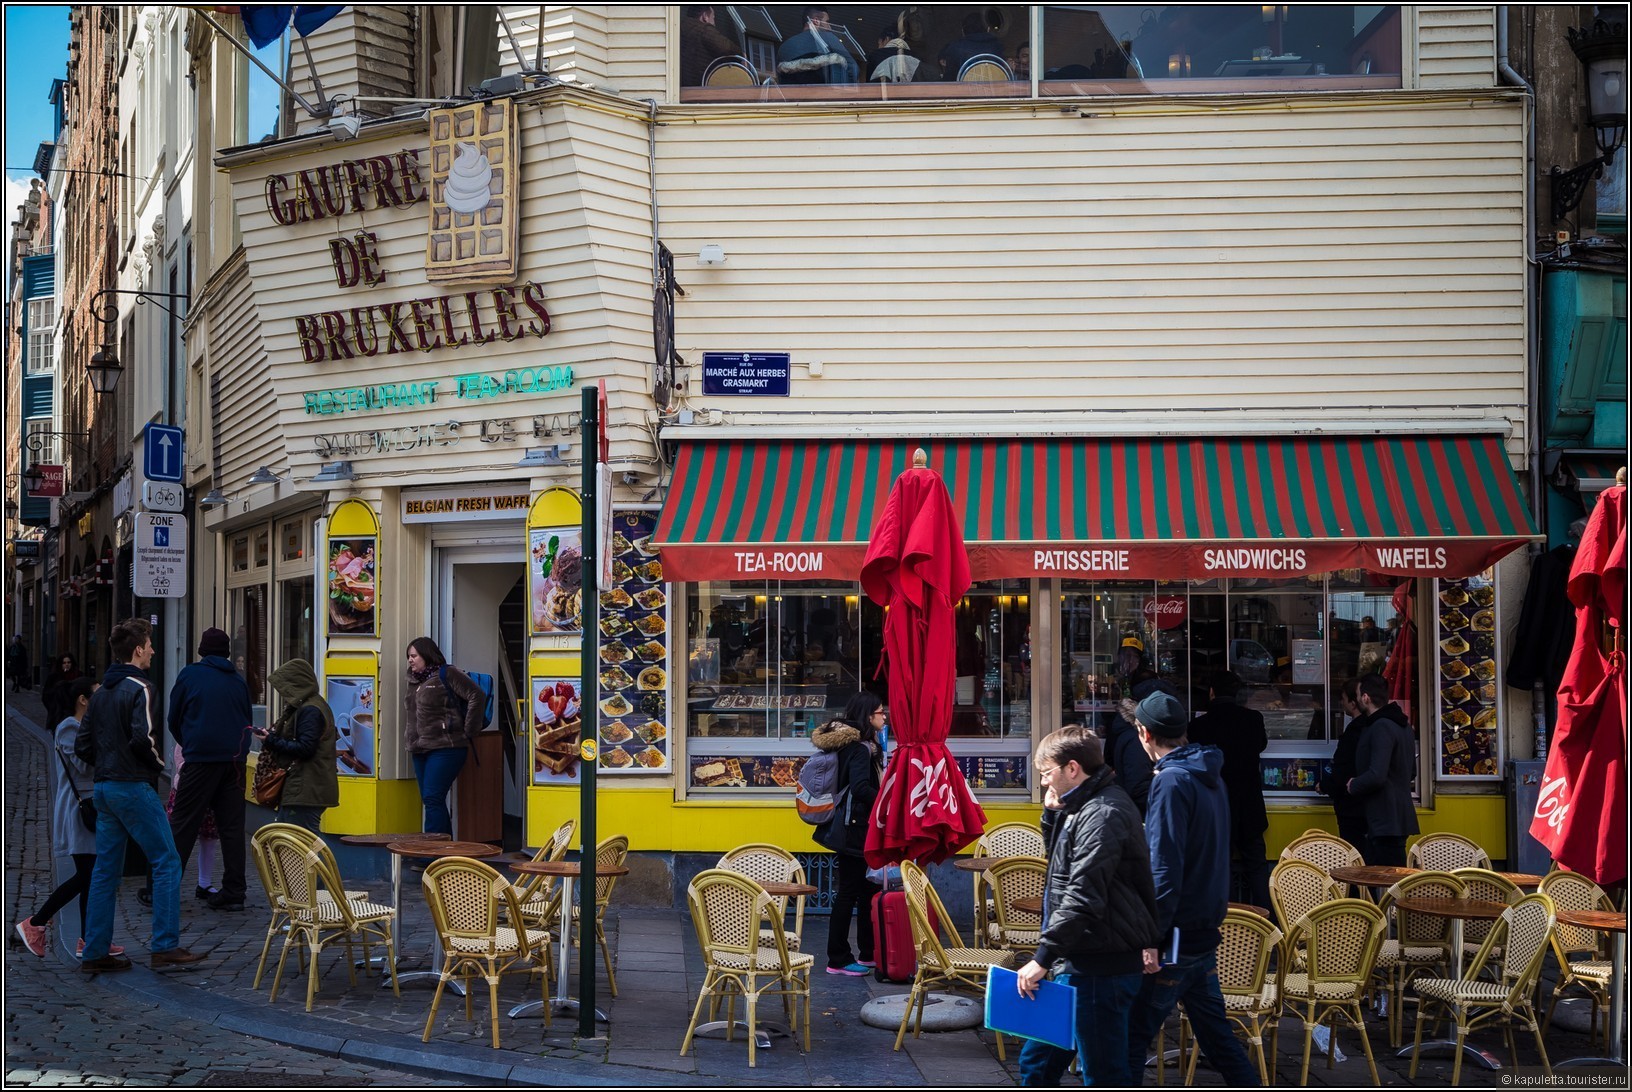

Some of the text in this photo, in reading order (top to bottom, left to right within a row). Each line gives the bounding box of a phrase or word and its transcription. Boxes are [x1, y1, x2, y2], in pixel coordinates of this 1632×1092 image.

[264, 149, 429, 226] GAUFRE
[328, 230, 386, 288] DE
[295, 280, 551, 364] BRUXELLES
[706, 367, 786, 378] MARCHÉ AUX HERBES
[723, 379, 769, 388] GRASMARKT
[304, 381, 439, 415] RESTAURANT
[314, 420, 461, 457] SANDWICHES
[479, 418, 516, 443] ICE
[406, 494, 531, 515] BELGIAN FRESH WAFFL
[150, 516, 174, 526] ZONE
[734, 552, 823, 572] TEA-ROOM
[1034, 550, 1129, 571] PATISSERIE
[1204, 549, 1306, 570] SANDWICHS
[1376, 547, 1446, 569] WAFELS
[551, 636, 570, 648] 113
